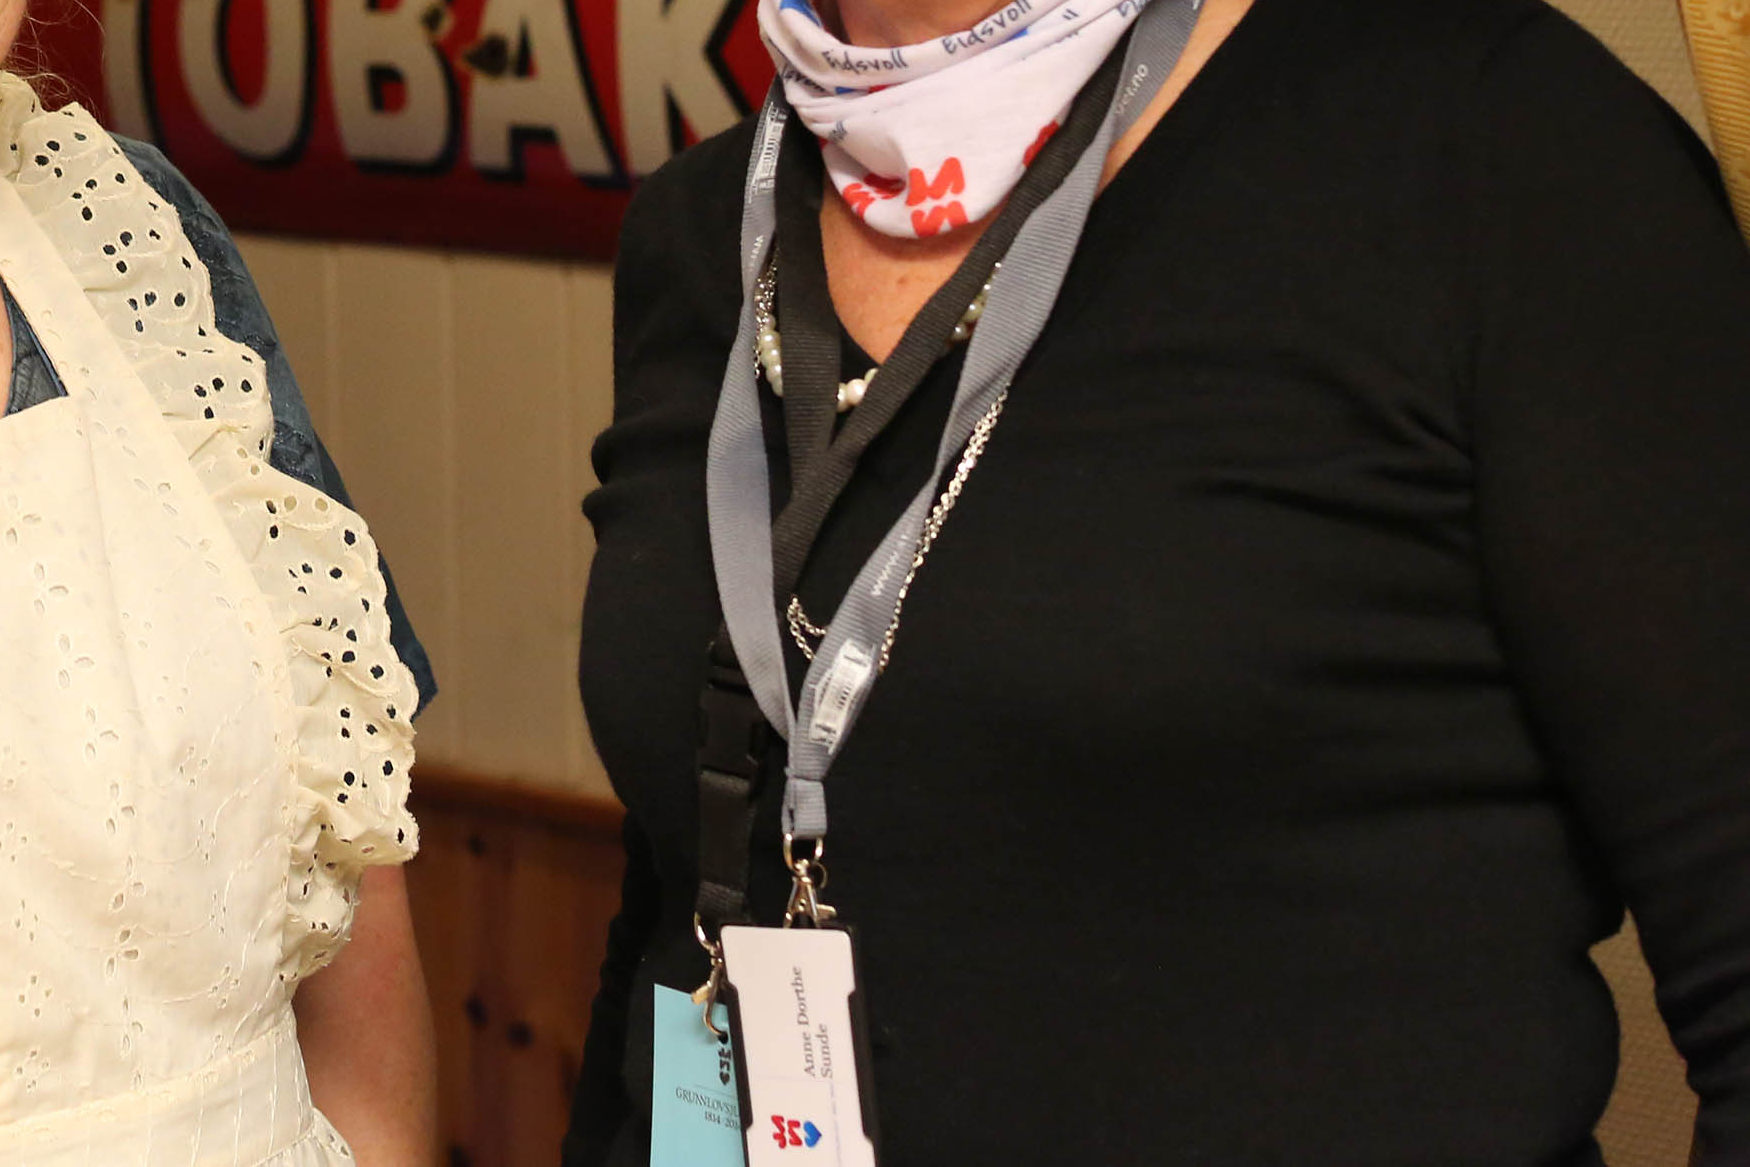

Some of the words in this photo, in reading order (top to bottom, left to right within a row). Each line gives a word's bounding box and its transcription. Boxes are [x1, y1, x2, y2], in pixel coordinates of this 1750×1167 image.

[791, 965, 811, 1027] Dorthe
[803, 1032, 817, 1077] Anne
[816, 1023, 834, 1080] Sunde
